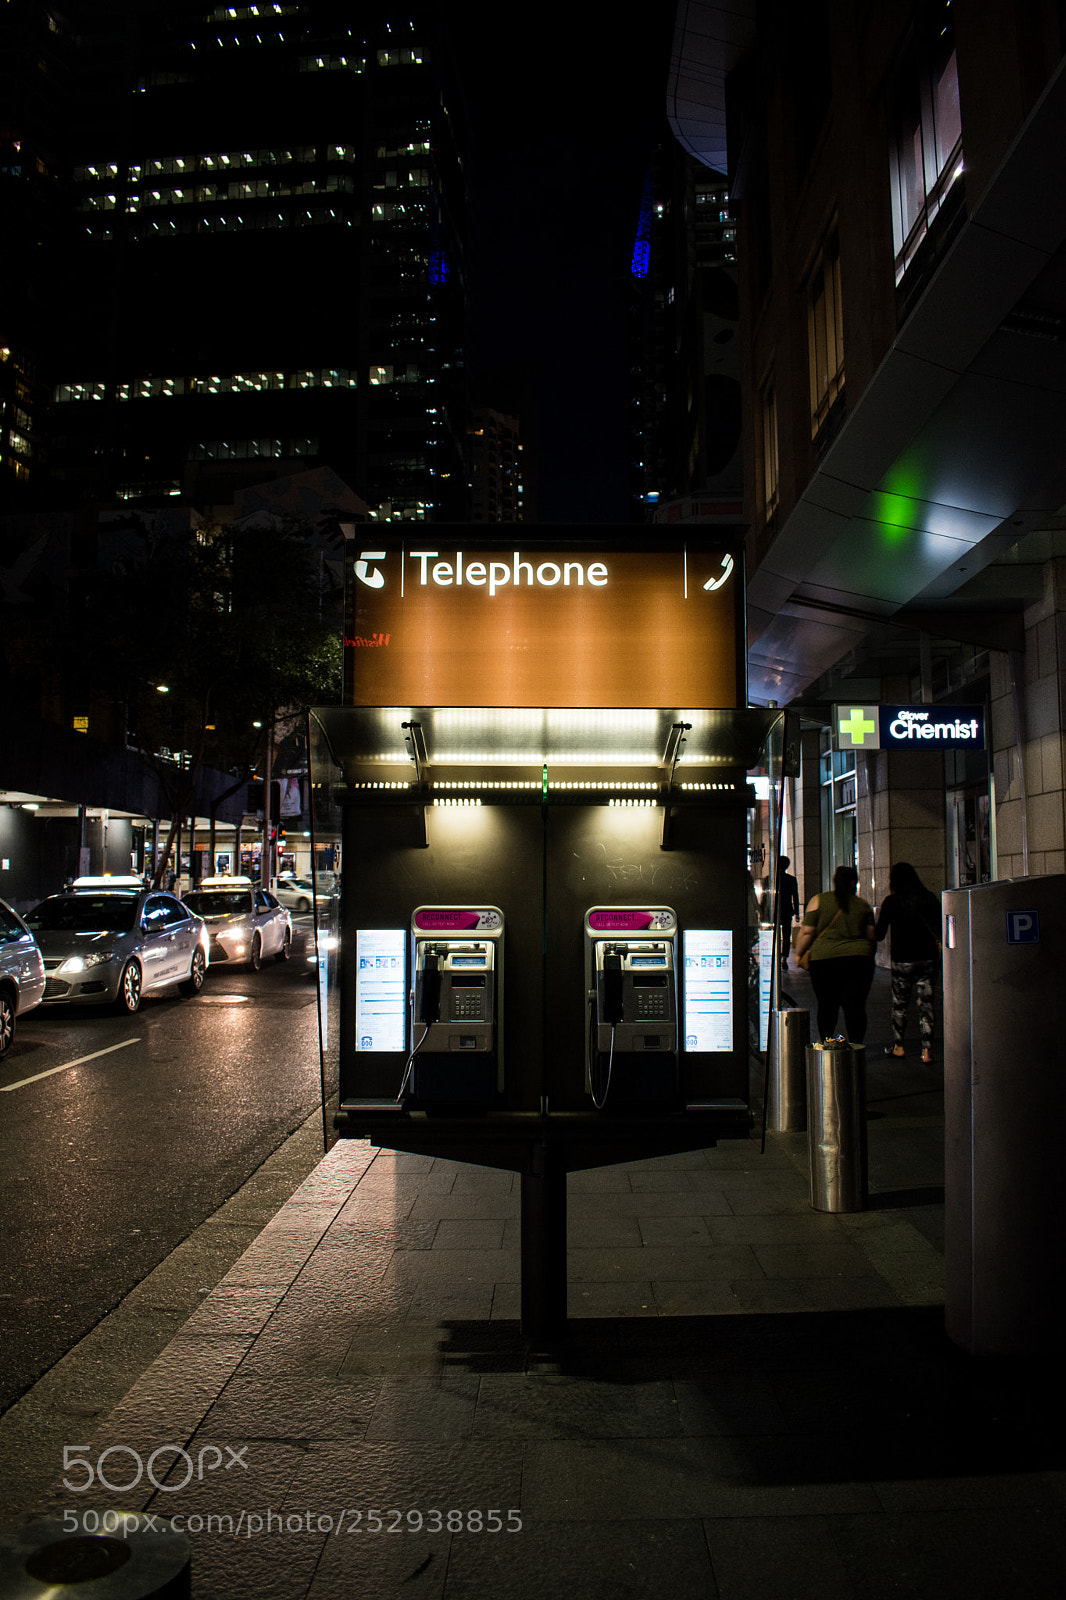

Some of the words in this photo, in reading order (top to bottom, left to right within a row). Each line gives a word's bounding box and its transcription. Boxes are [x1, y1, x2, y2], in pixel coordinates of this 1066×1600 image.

[410, 551, 608, 596] Telephone
[898, 710, 929, 721] Glover
[889, 719, 979, 739] Chemist
[1013, 914, 1033, 940] P
